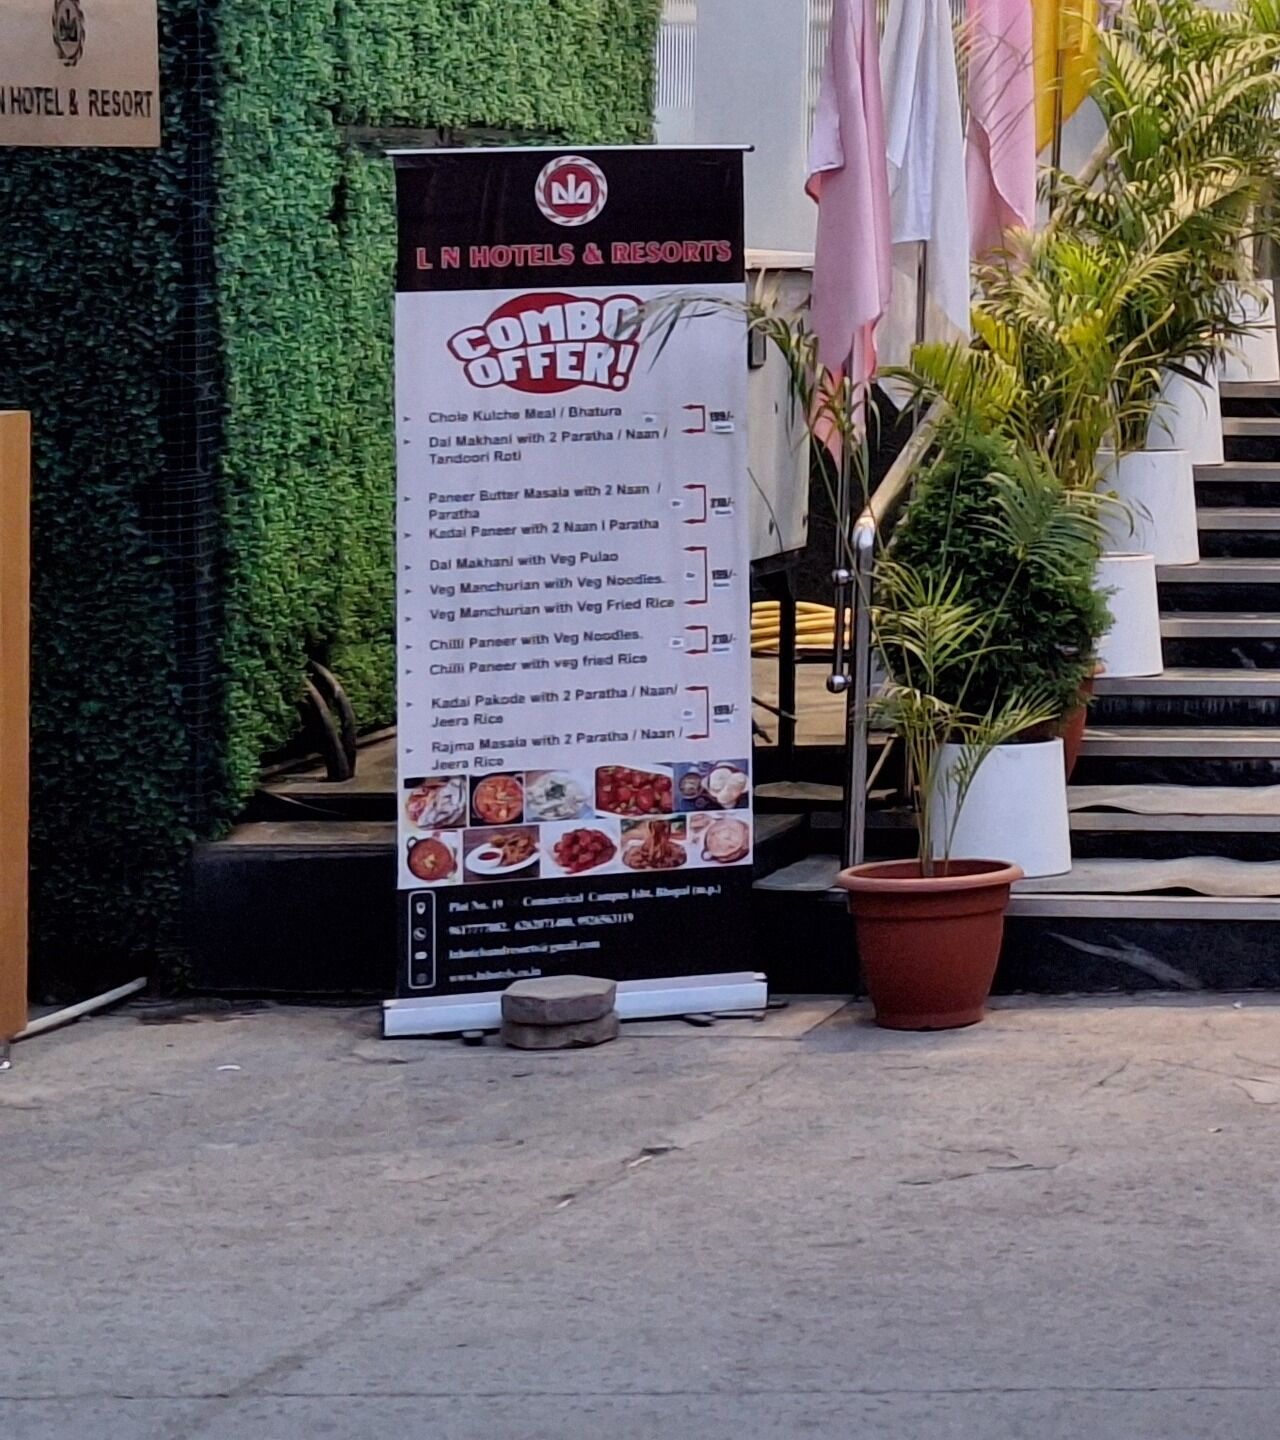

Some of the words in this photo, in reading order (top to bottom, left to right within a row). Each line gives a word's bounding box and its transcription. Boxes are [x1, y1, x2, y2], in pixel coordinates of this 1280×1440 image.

[10, 86, 64, 117] HOTEL
[69, 88, 79, 116] &
[89, 88, 153, 118] RESORT
[469, 243, 575, 268] HOTELS
[582, 242, 604, 265] &
[611, 240, 733, 264] RESORTS
[450, 298, 643, 361] COMBO
[467, 342, 637, 388] OFFER!
[456, 434, 512, 446] Makhani
[517, 433, 545, 444] with
[550, 432, 557, 443] 2
[562, 431, 613, 442] Paratha
[626, 429, 659, 440] Naan
[429, 452, 489, 464] Tandoori
[494, 450, 522, 462] Roti
[429, 492, 475, 504] Paneer
[480, 490, 520, 501] Butter
[524, 486, 569, 499] Masala
[574, 486, 601, 497] with
[605, 485, 612, 495] 2
[617, 484, 650, 495] Naan
[429, 508, 480, 520] Paratha
[471, 526, 517, 538] Paneer
[521, 523, 548, 535] with
[552, 522, 559, 533] 2
[564, 521, 597, 532] Naan
[609, 519, 659, 531] Paratha
[456, 556, 513, 569] Makhani
[517, 555, 546, 566] with
[551, 553, 576, 566] Veg
[580, 551, 619, 563] Pulao
[430, 584, 455, 597] Veg
[460, 579, 540, 593] Manchurian
[544, 577, 572, 589] with
[577, 576, 602, 589] Veg
[430, 609, 455, 622] Veg
[460, 605, 540, 618] Manchurian
[544, 603, 572, 614] with
[577, 601, 602, 614] Veg
[606, 599, 641, 611] Fried
[645, 597, 675, 608] Rice
[469, 637, 517, 648] Paneer
[521, 634, 549, 645] with
[554, 632, 579, 645] Veg
[469, 662, 517, 673] Paneer
[521, 658, 549, 670] with
[583, 654, 613, 667] fried
[618, 653, 648, 664] Rice
[530, 691, 559, 703] with
[564, 690, 571, 701] 2
[575, 688, 627, 700] Paratha
[431, 716, 469, 728] Jeera
[474, 713, 504, 724] Rice
[432, 741, 474, 754] Rajma
[480, 737, 527, 750] Masala
[532, 734, 560, 746] with
[565, 734, 572, 744] 2
[576, 731, 629, 743] Paratha
[641, 728, 675, 739] Naan
[431, 759, 469, 770] Jeera
[474, 756, 504, 768] Rice
